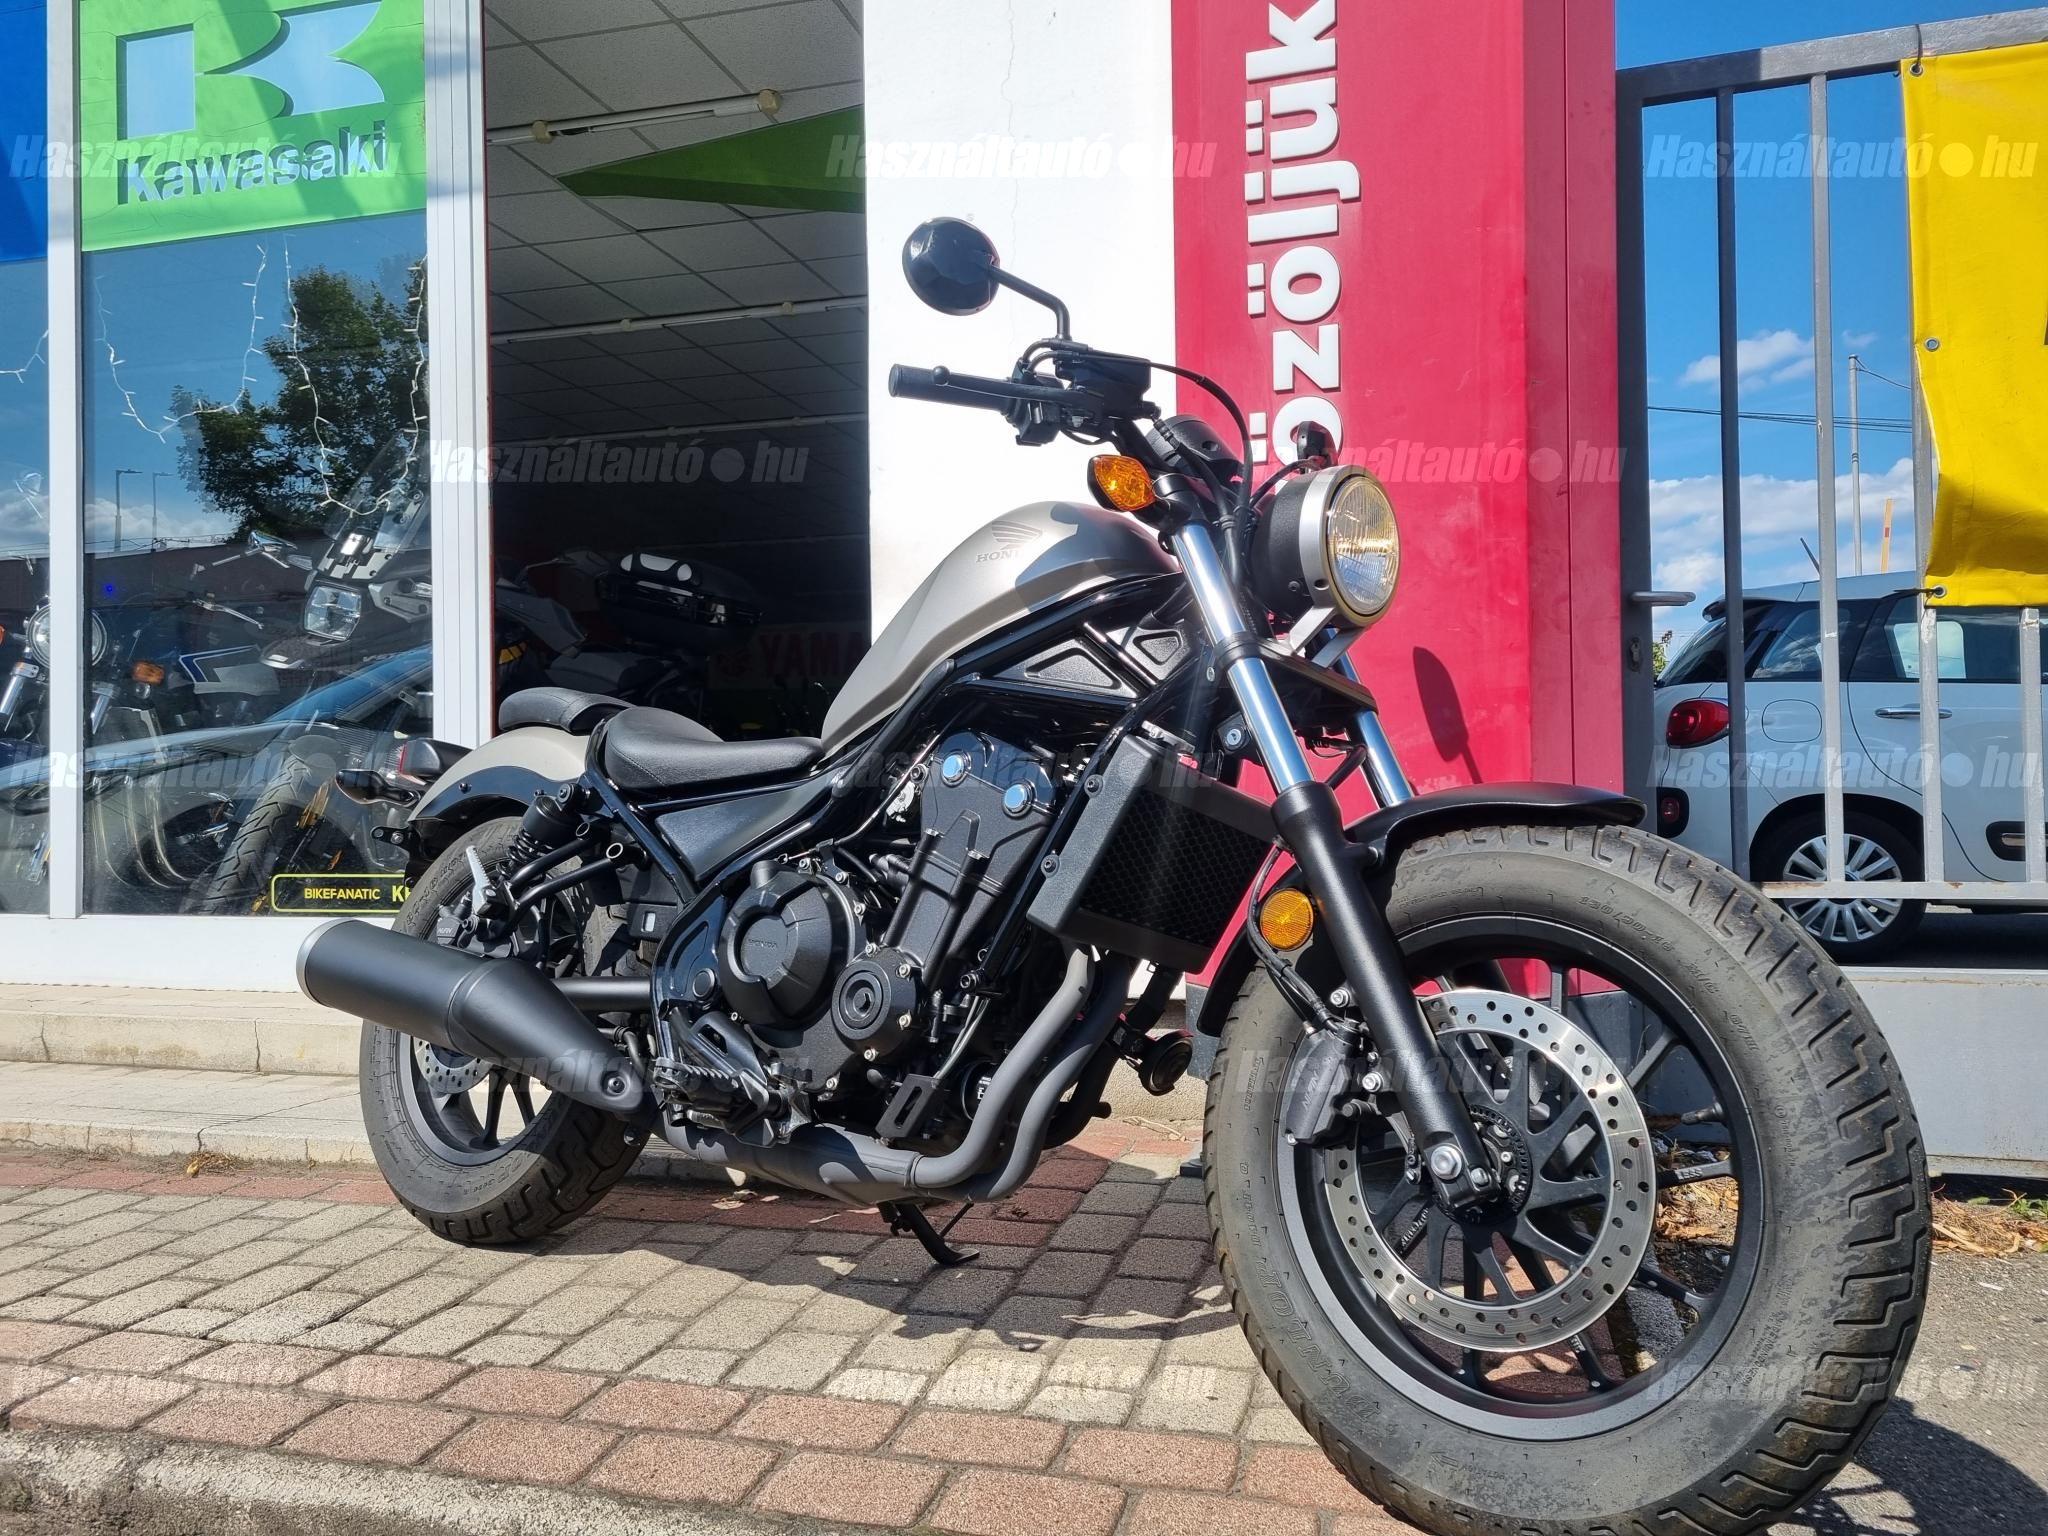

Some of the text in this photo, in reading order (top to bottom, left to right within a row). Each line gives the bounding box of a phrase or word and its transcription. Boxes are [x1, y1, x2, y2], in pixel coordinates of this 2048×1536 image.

[117, 119, 386, 206] Kawasaki
[1244, 0, 1361, 491] özöljük
[304, 887, 381, 900] BIKEFANATIC
